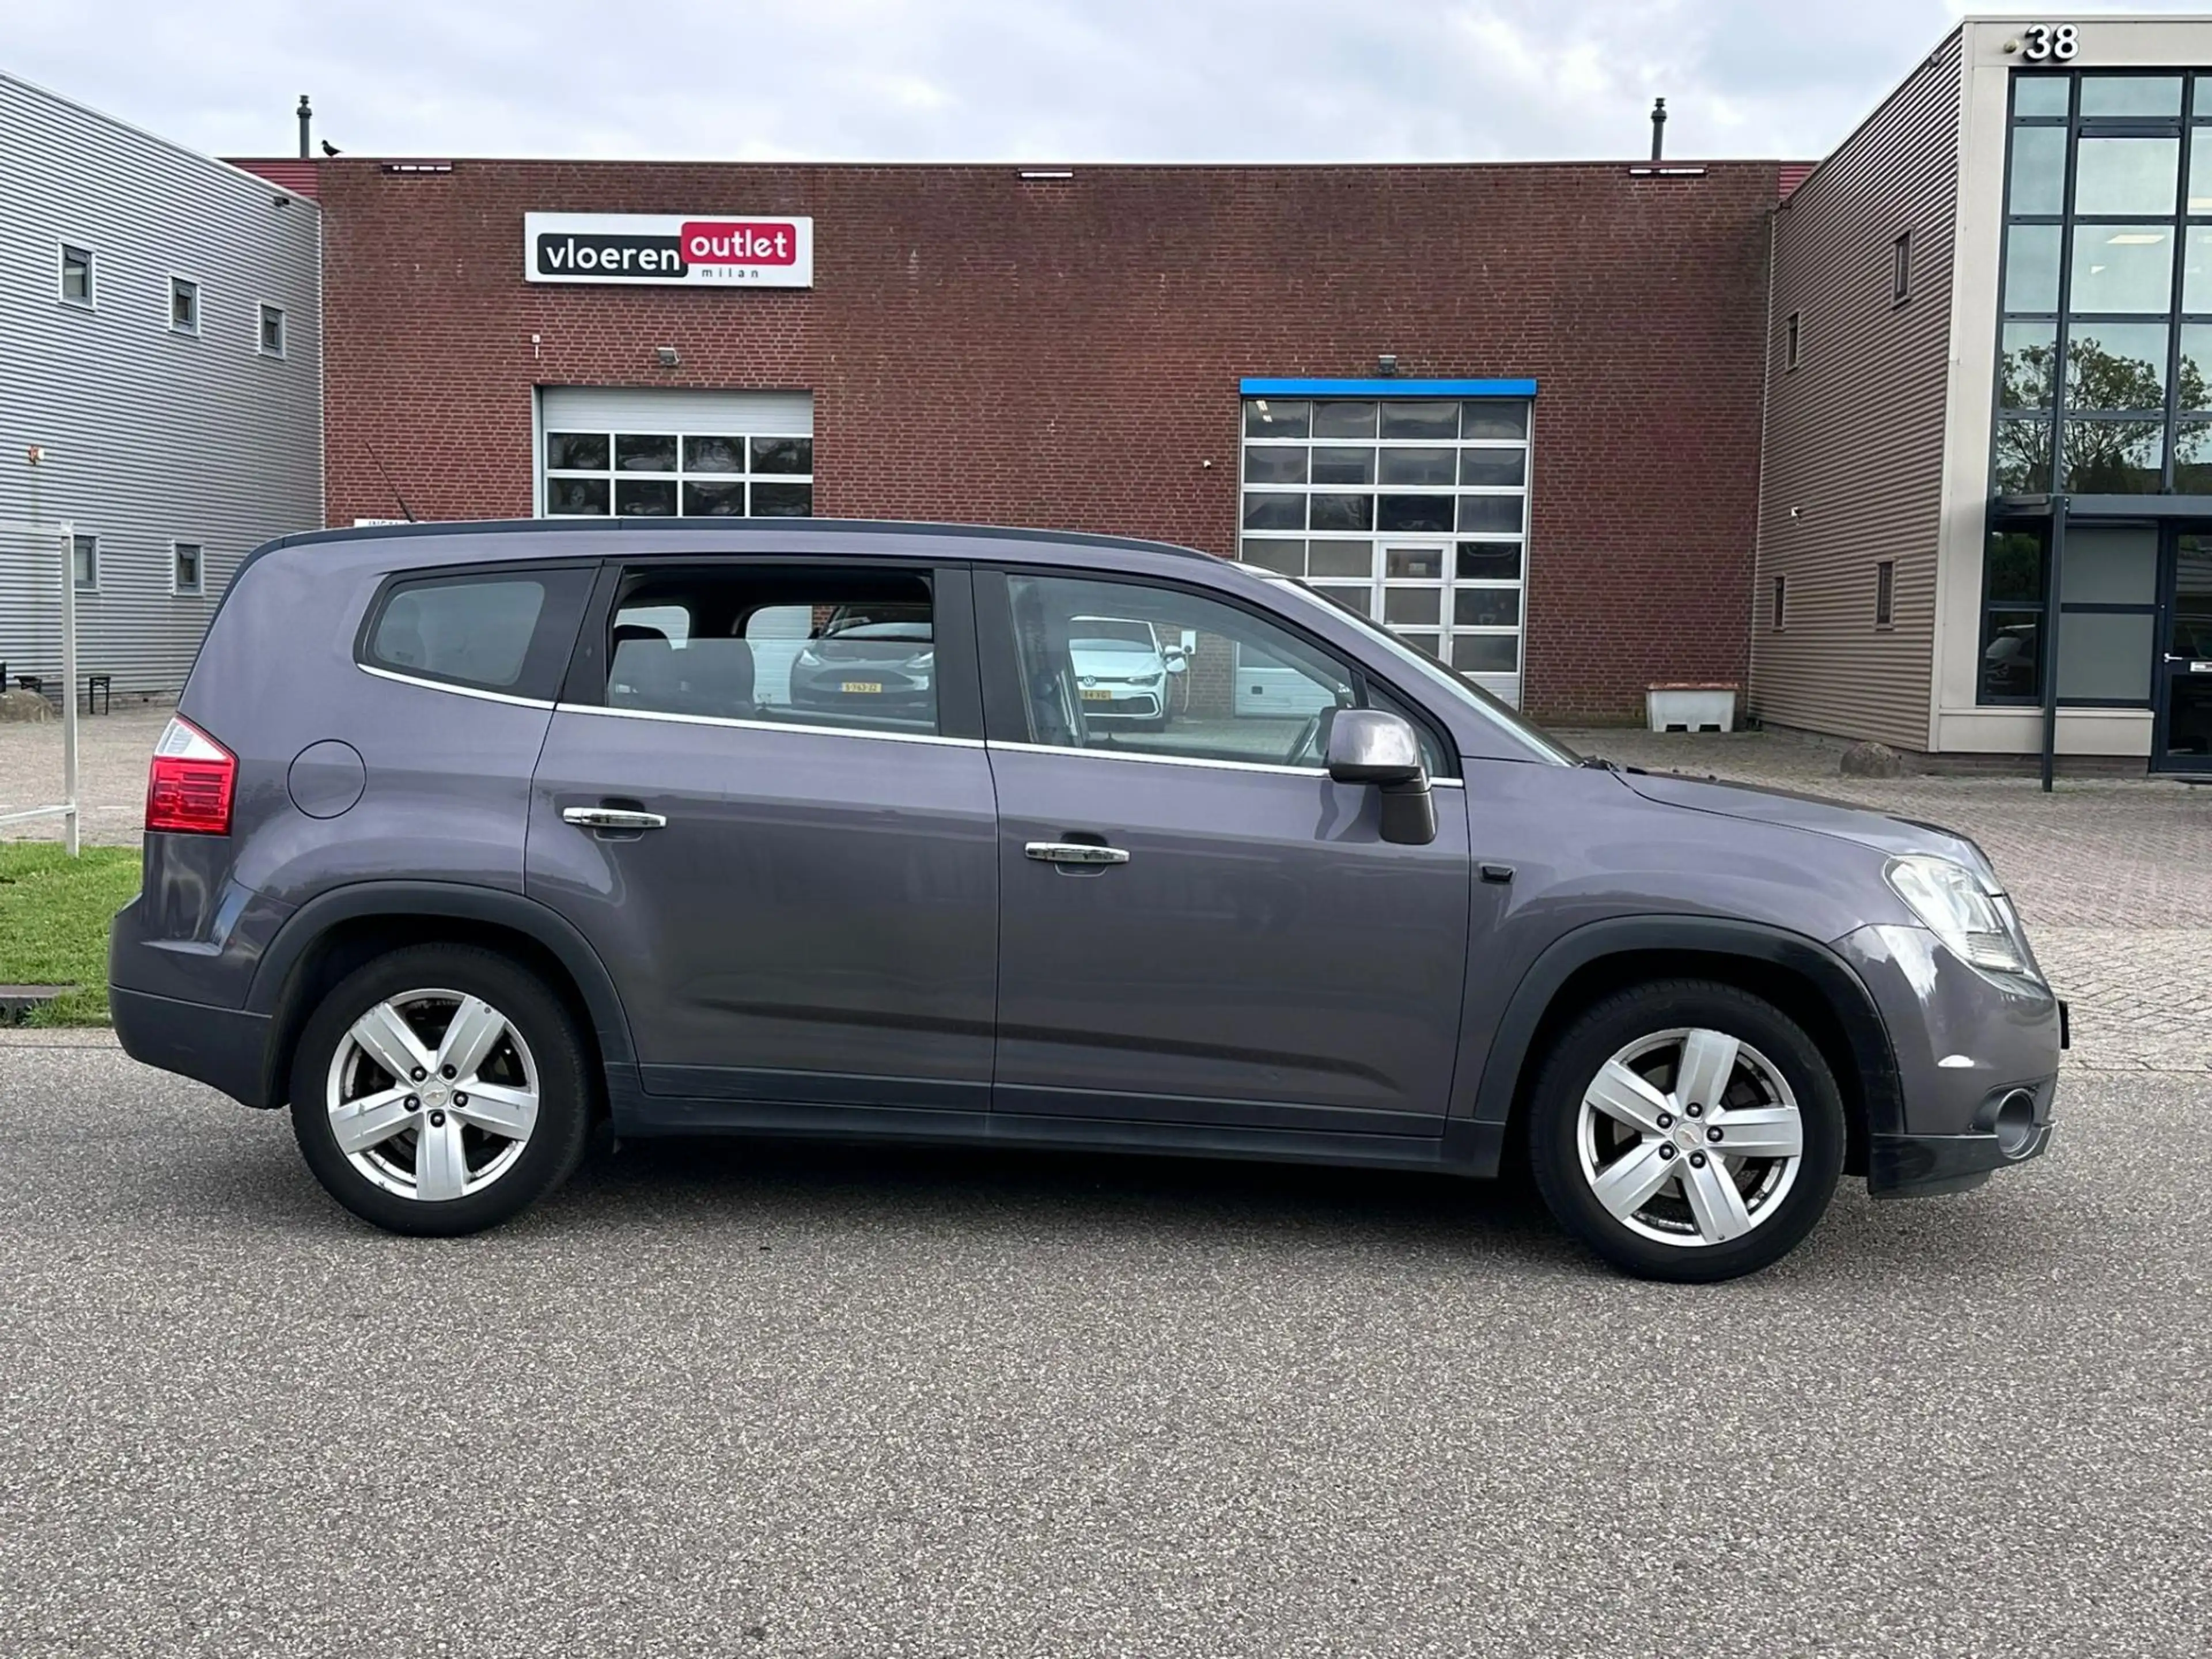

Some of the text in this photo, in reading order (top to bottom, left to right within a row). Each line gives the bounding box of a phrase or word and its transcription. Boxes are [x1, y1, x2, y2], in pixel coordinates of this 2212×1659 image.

[2024, 23, 2080, 60] 38
[545, 229, 788, 271] vloeren outlet
[702, 267, 759, 278] milan
